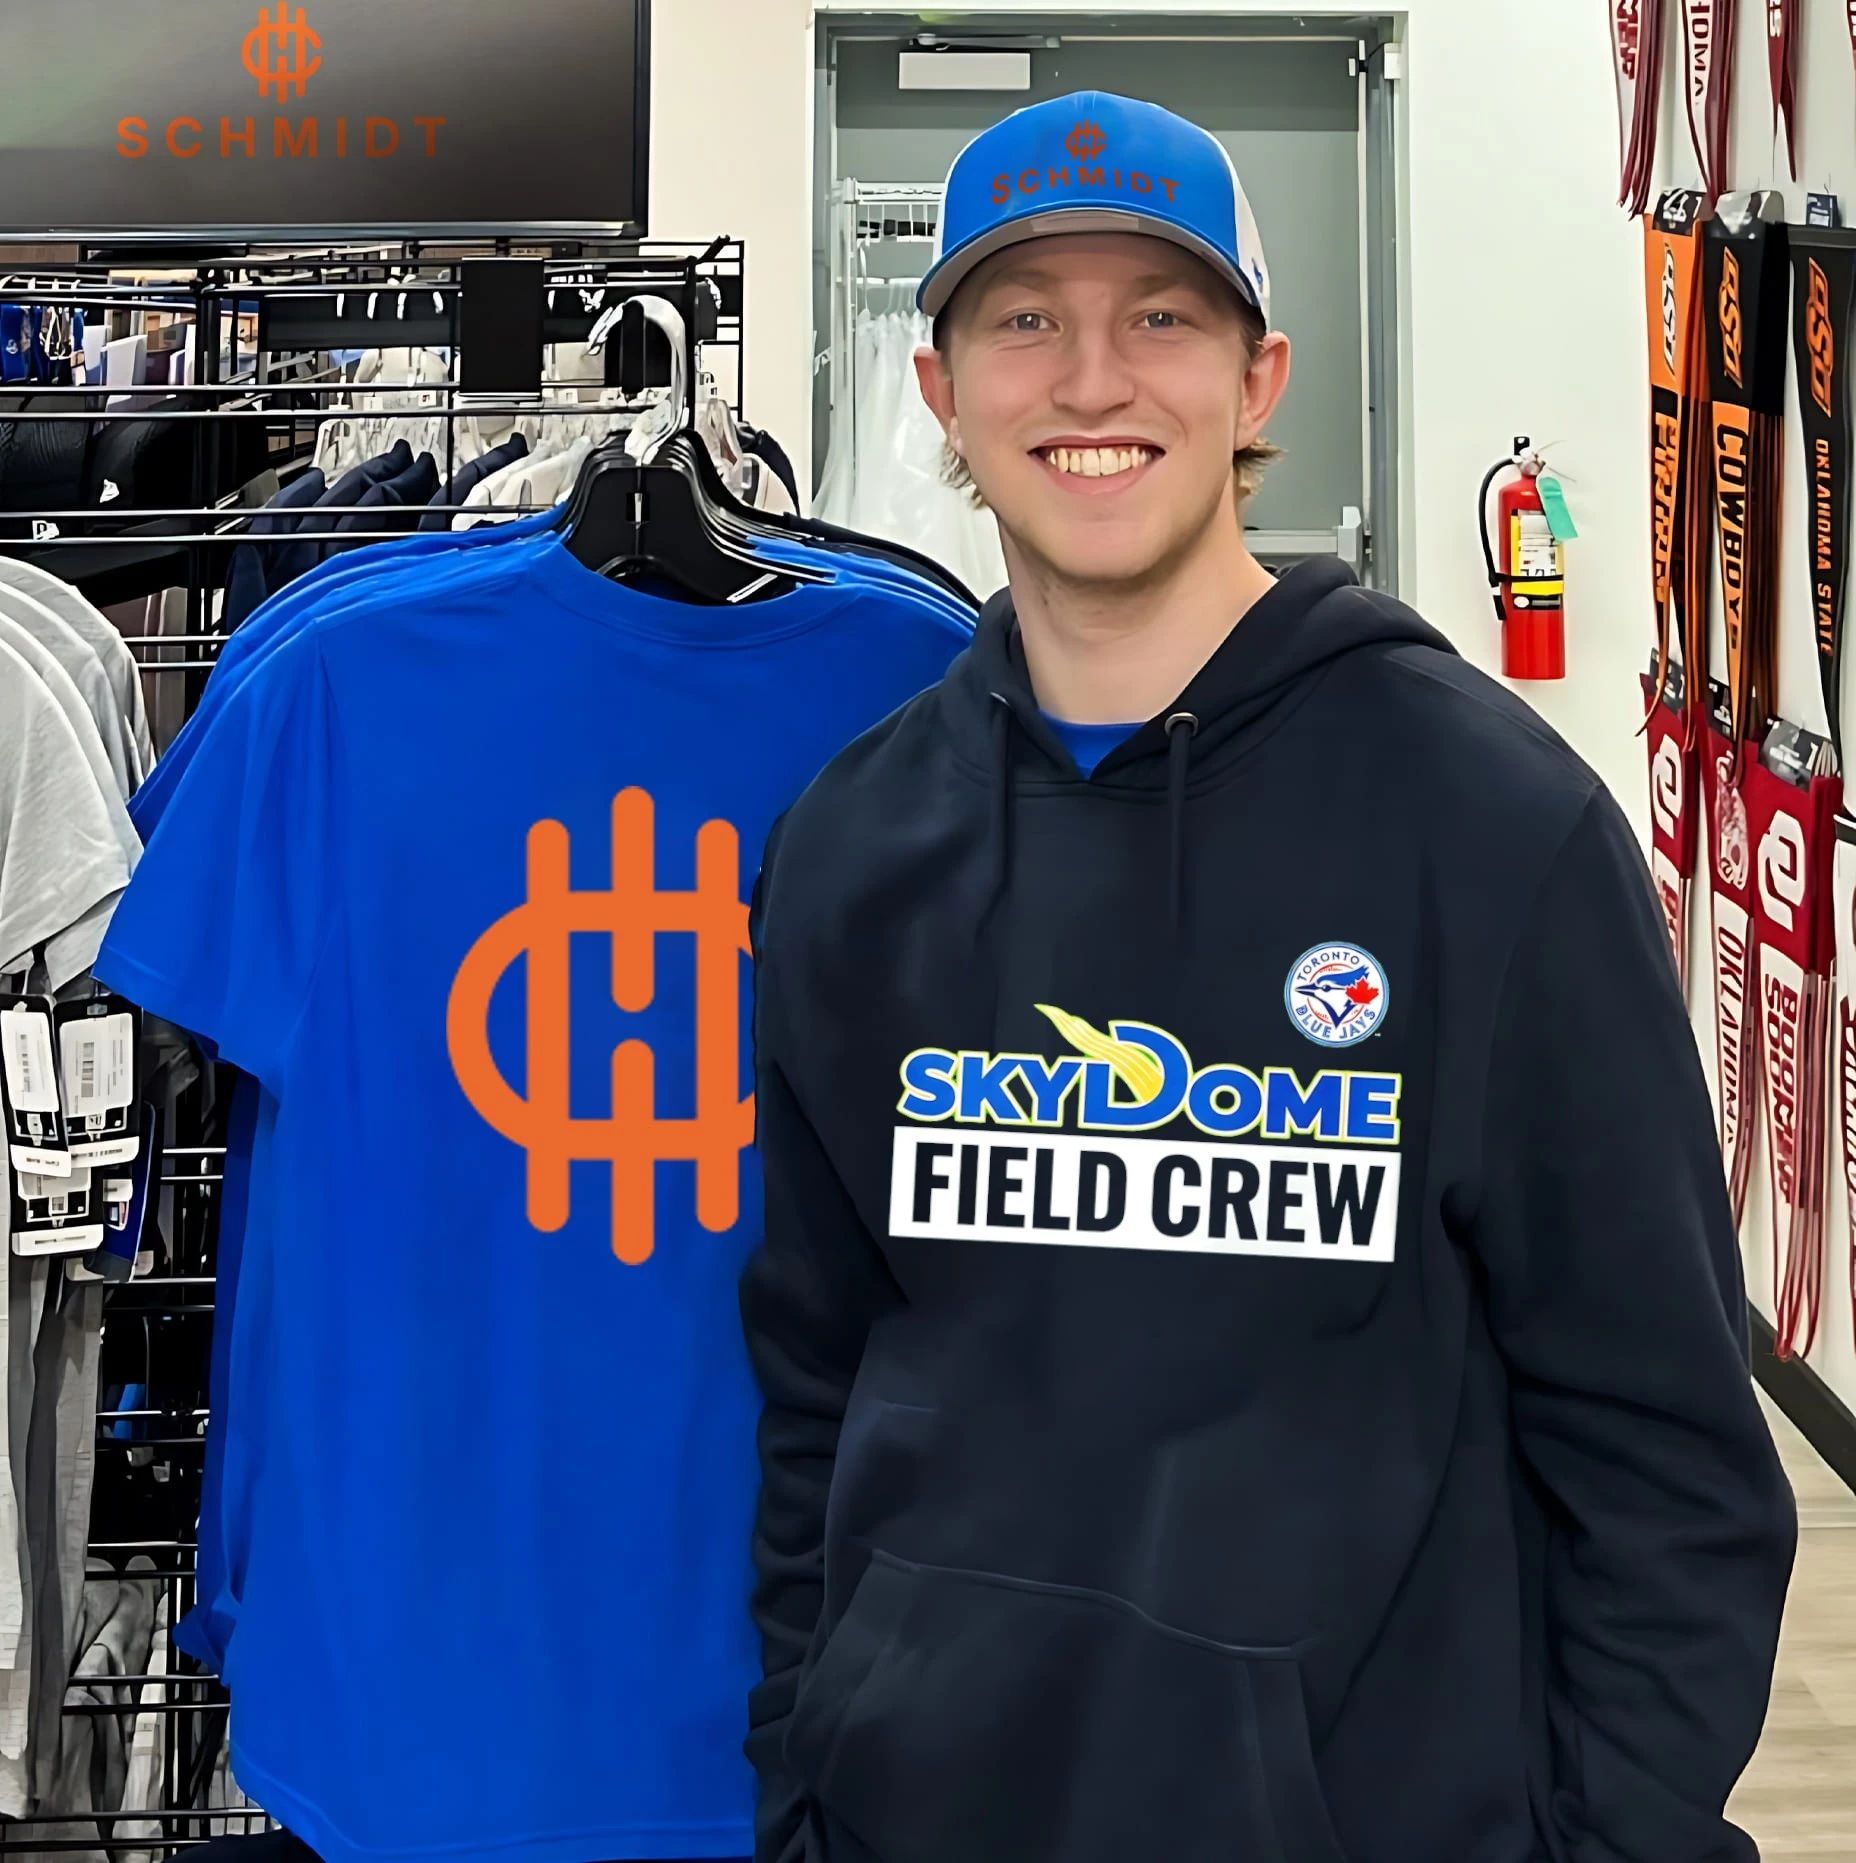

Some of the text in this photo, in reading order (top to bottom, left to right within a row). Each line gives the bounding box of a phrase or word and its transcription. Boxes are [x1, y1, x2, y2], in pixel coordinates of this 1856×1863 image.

[116, 116, 448, 159] SCHMIDT
[991, 166, 1180, 205] SCHMIDT
[1815, 438, 1832, 570] OKLAHOMA
[1297, 951, 1360, 981] TORONTO
[1296, 1004, 1376, 1039] BLUE JAYS
[1718, 926, 1745, 1145] OKLAHOMA
[897, 1018, 1402, 1145] SKYDOME
[912, 1141, 1386, 1247] FIELD CREW
